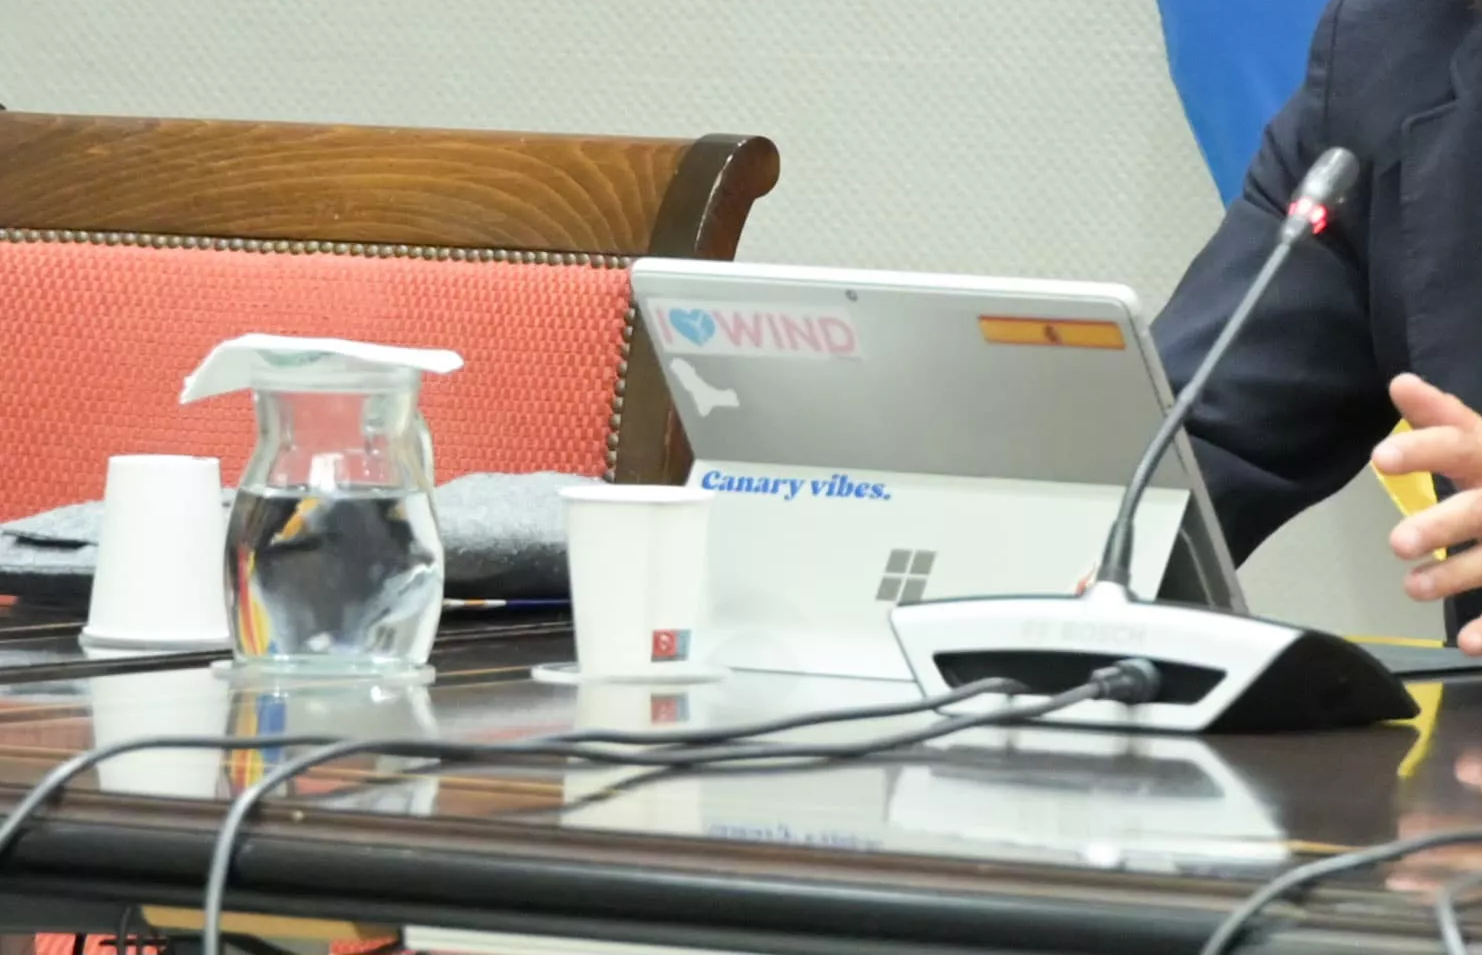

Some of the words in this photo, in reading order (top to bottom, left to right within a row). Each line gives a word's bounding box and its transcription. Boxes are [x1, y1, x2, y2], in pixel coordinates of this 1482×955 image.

[713, 310, 856, 354] WIND
[701, 470, 805, 500] Canary
[810, 474, 892, 500] vibes.
